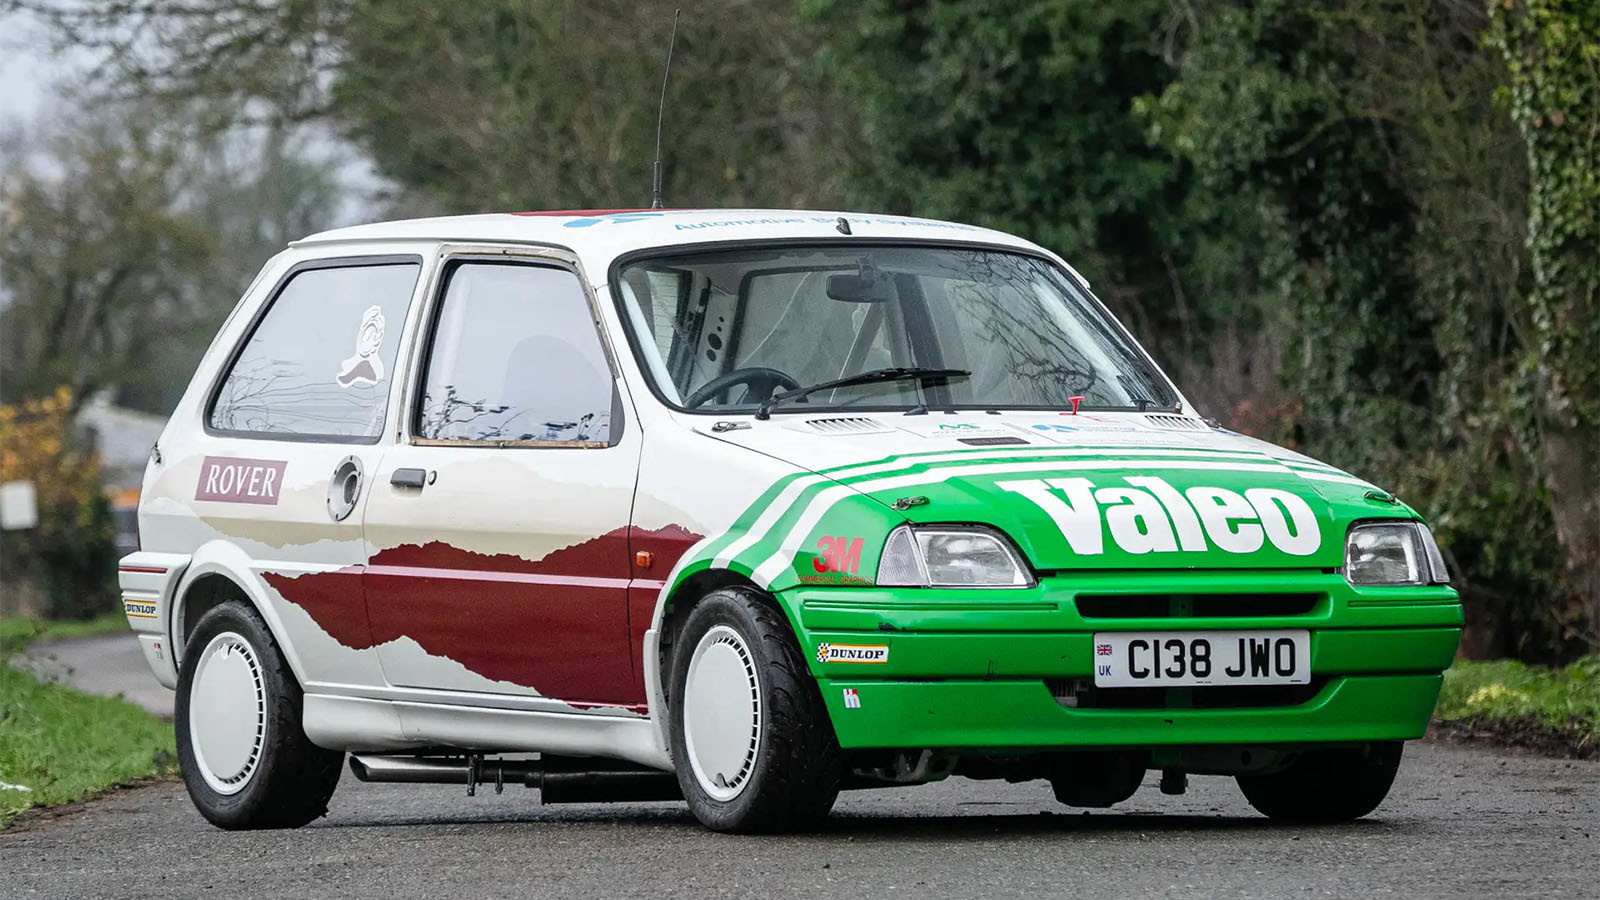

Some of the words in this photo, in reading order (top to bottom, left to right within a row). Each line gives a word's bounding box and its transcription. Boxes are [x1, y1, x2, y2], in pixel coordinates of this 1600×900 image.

[675, 217, 804, 230] Automotive
[811, 217, 871, 225] Boy
[205, 464, 277, 497] ROVER
[994, 476, 1321, 555] Valeo
[813, 535, 864, 574] 3M
[795, 575, 835, 585] COMMERCIAL
[839, 576, 874, 585] GRAPHICS
[126, 604, 156, 614] DUNLOP
[830, 649, 884, 659] DUNLOP
[1128, 639, 1211, 679] C138
[1225, 638, 1296, 677] JWO
[1098, 665, 1112, 677] UK
